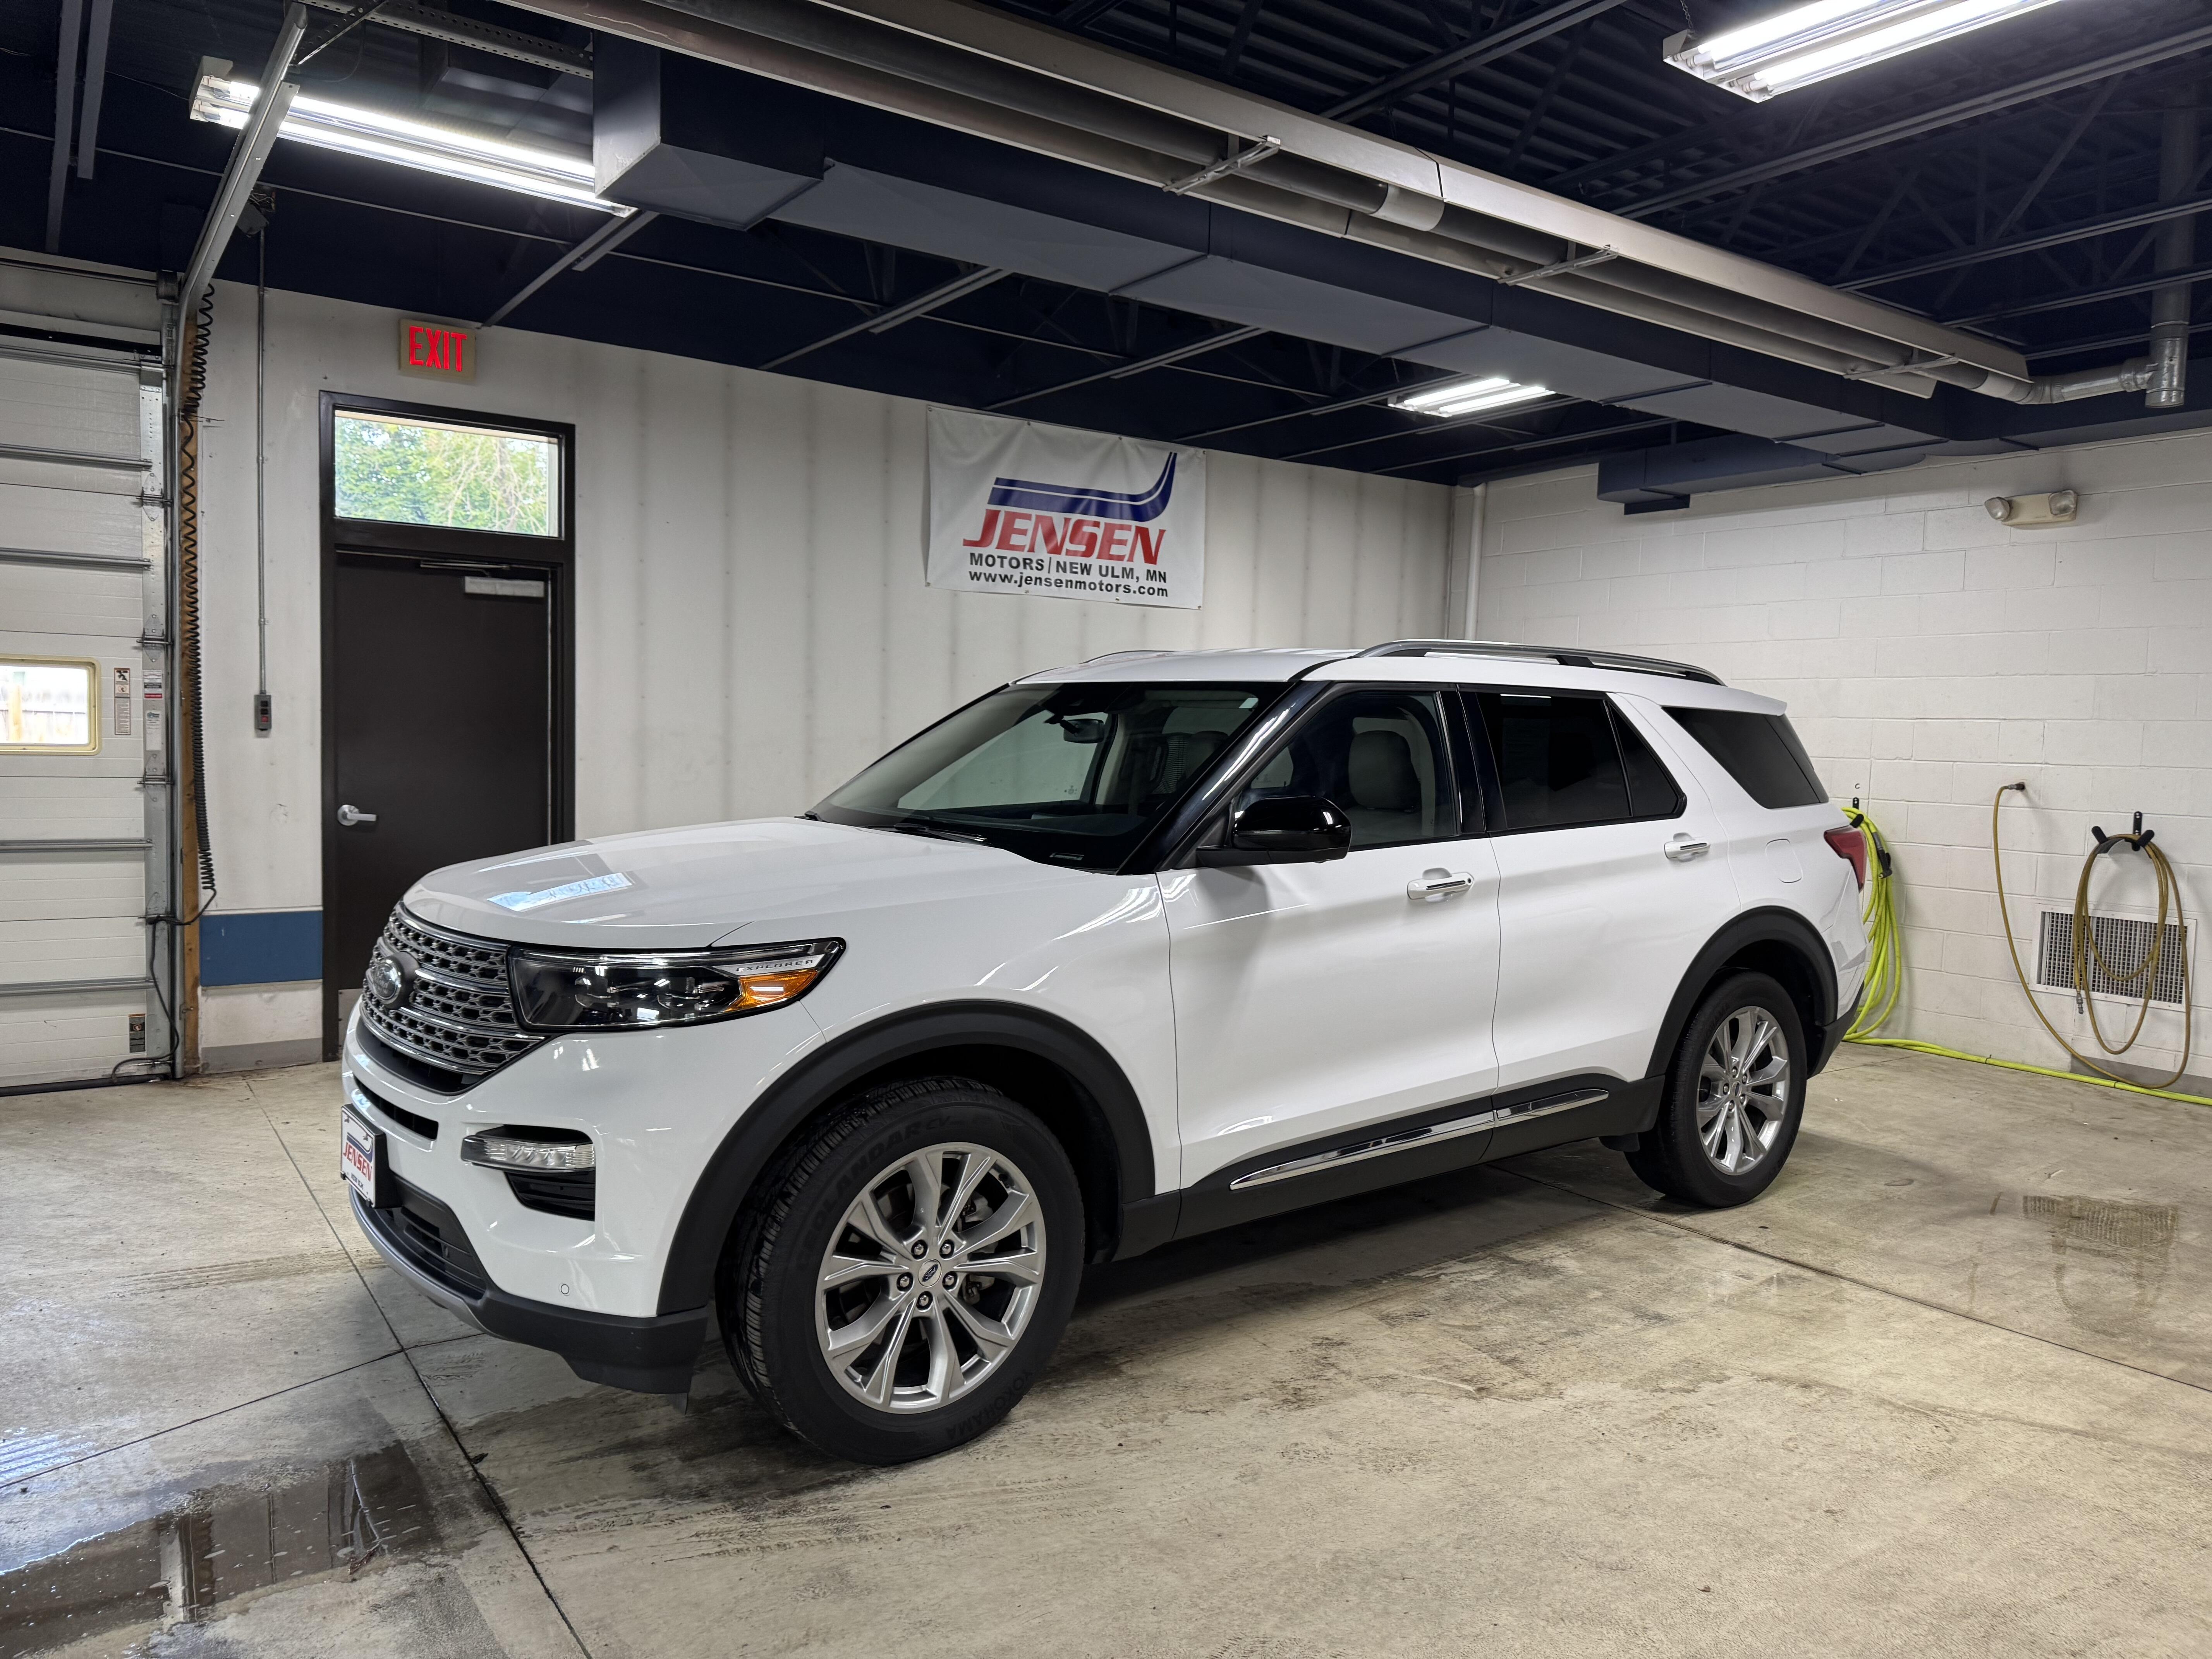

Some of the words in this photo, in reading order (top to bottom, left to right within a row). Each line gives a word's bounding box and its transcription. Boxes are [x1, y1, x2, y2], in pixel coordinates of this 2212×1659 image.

[409, 326, 467, 371] EXIT
[963, 508, 1166, 565] JENSEN
[969, 571, 1168, 597] www.jensenmotors.com
[970, 553, 1044, 571] MOTORS
[1056, 560, 1092, 575] NEW
[1099, 565, 1139, 582] ULM,
[1146, 569, 1166, 583] MN
[736, 960, 813, 972] EXPLORER
[343, 1142, 372, 1182] JENSEN
[946, 1369, 1033, 1440] YOKOHAMA
